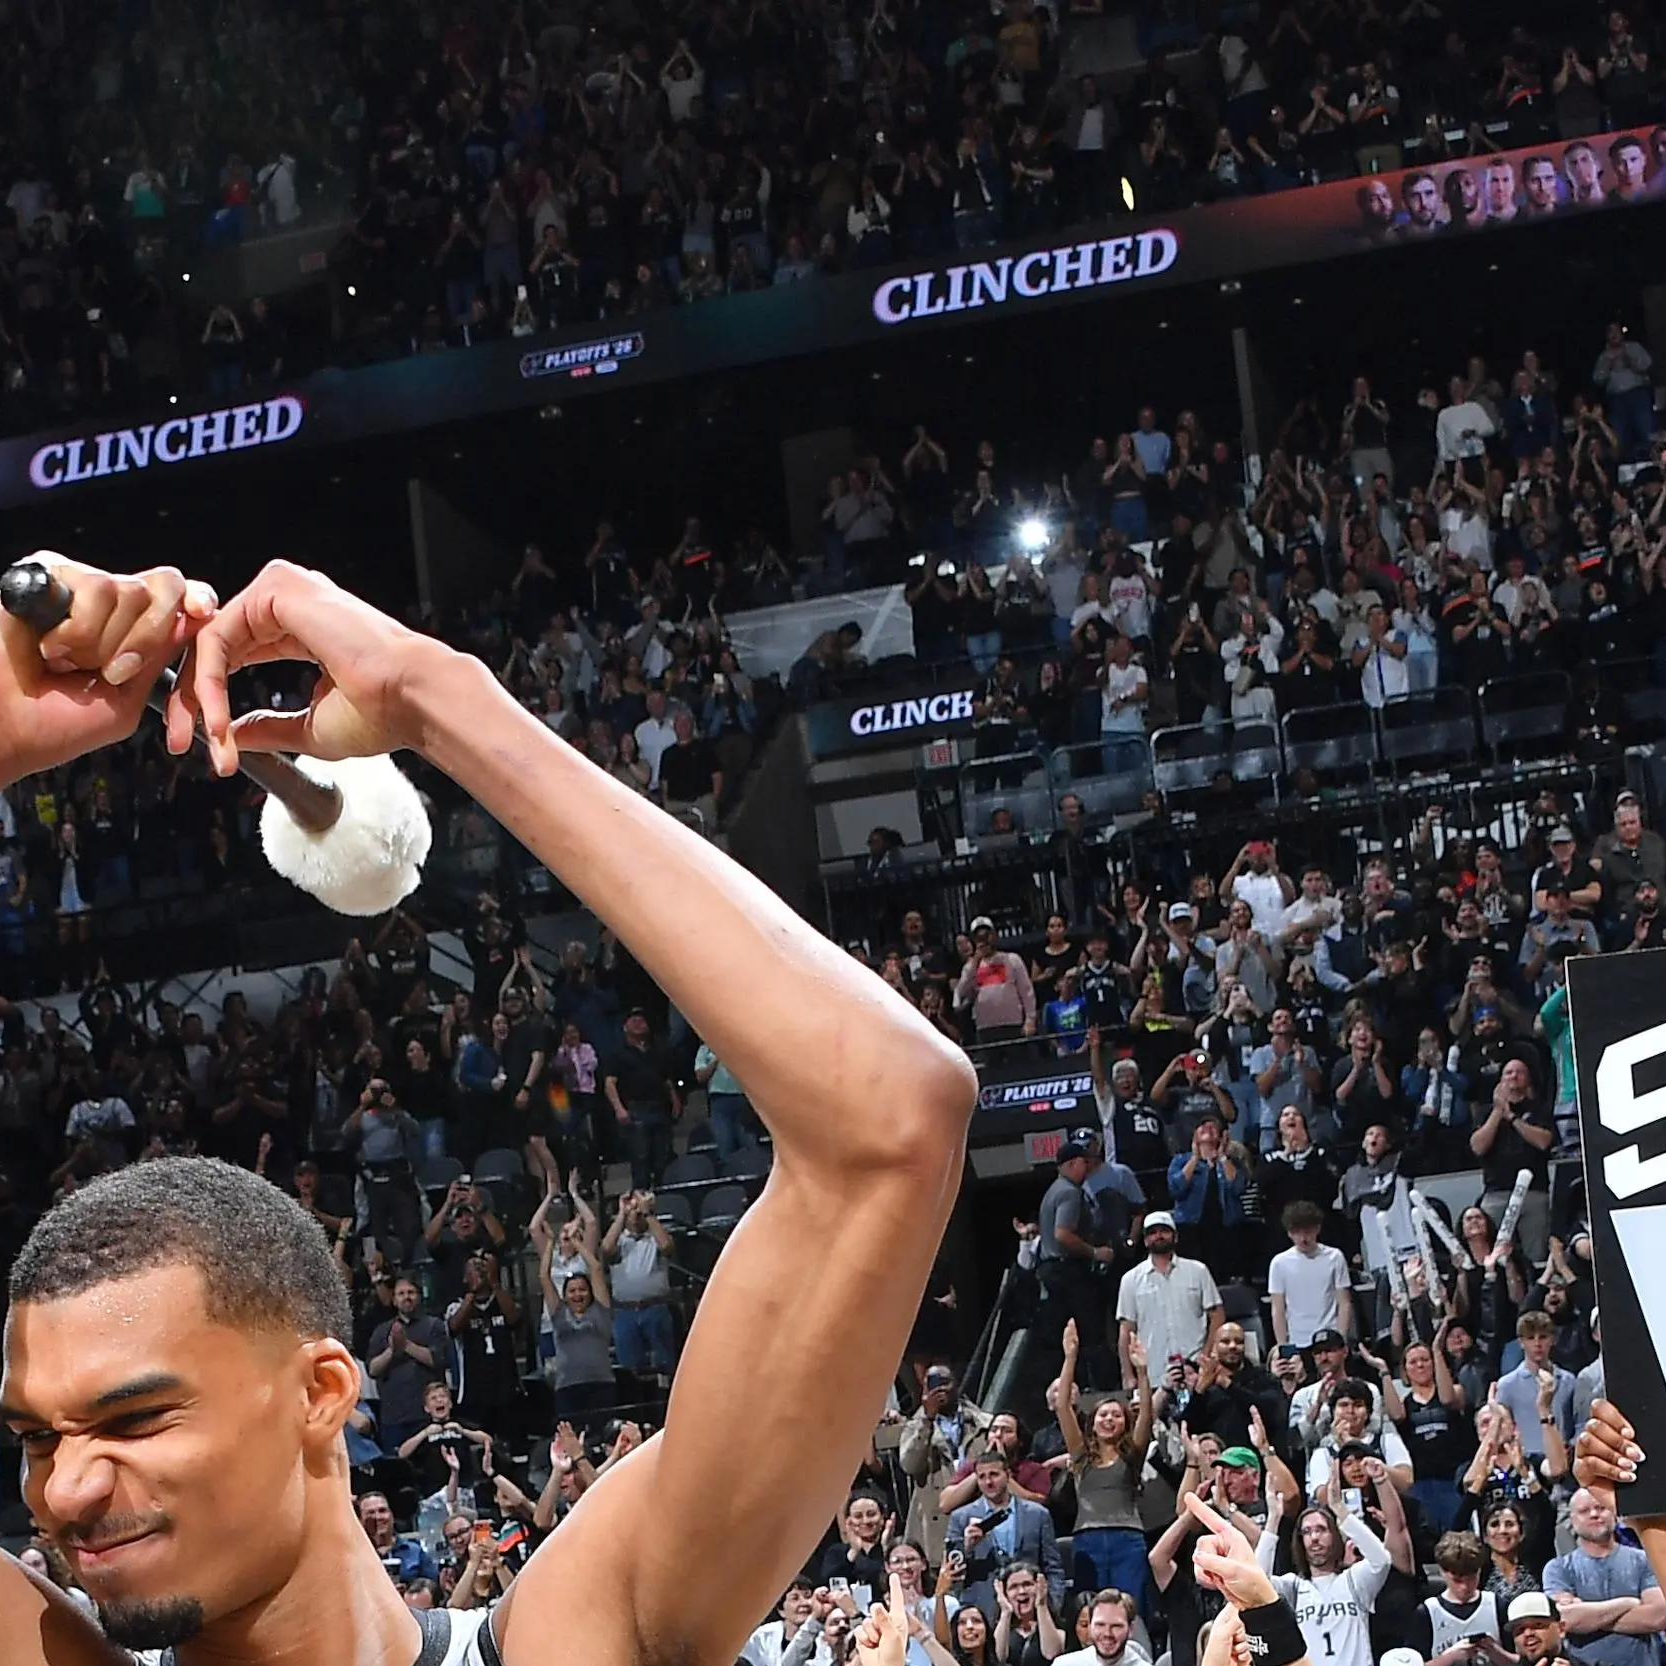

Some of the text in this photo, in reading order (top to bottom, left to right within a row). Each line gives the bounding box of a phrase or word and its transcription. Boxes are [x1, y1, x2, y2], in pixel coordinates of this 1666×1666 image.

[873, 228, 1180, 324] CLINCHED
[544, 344, 610, 369] PLAYOFFS
[29, 394, 305, 488] CLINCHED
[850, 690, 975, 736] CLINCH
[1003, 1075, 1093, 1102] PLAYOFFS '26
[1133, 1113, 1161, 1136] 20
[1323, 1632, 1334, 1656] 1
